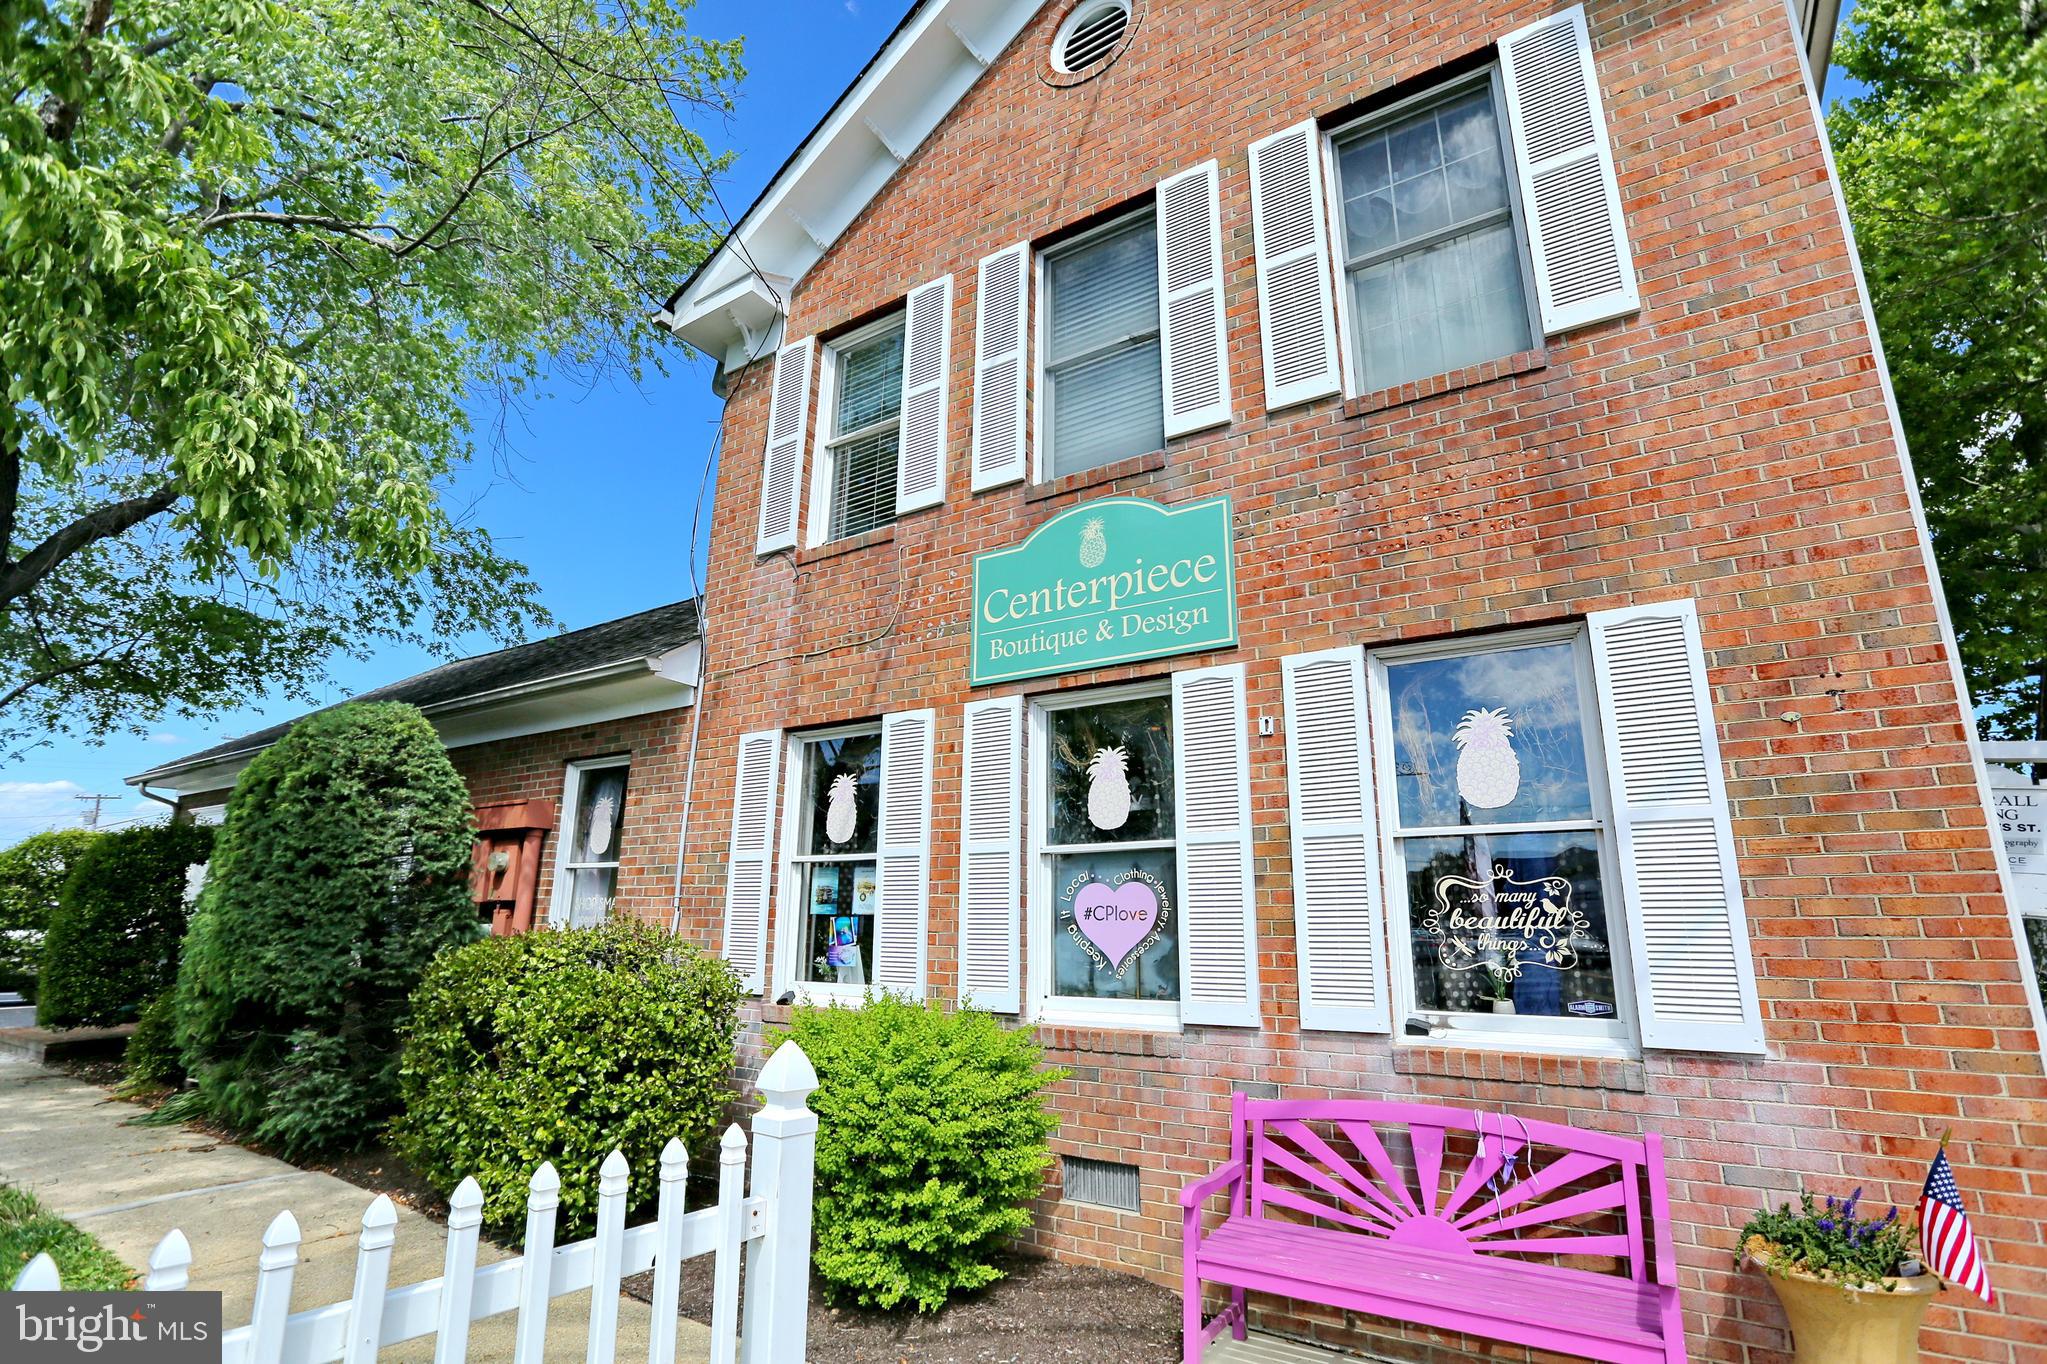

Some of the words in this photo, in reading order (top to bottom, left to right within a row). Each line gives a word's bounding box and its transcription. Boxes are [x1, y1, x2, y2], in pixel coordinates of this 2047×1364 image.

[983, 554, 1217, 624] Centerpiece
[990, 629, 1088, 660] Boutique
[1095, 619, 1115, 642] &
[1121, 606, 1209, 635] Design
[2016, 823, 2041, 833] ST.
[1113, 868, 1155, 885] Clothing
[1060, 909, 1071, 920] It
[1083, 905, 1148, 921] #CPlove
[1154, 880, 1172, 929] Jewelery
[1494, 892, 1537, 910] many
[1449, 906, 1567, 939] beautiful
[1067, 923, 1108, 971] Keeping
[1116, 930, 1161, 980] Accessories
